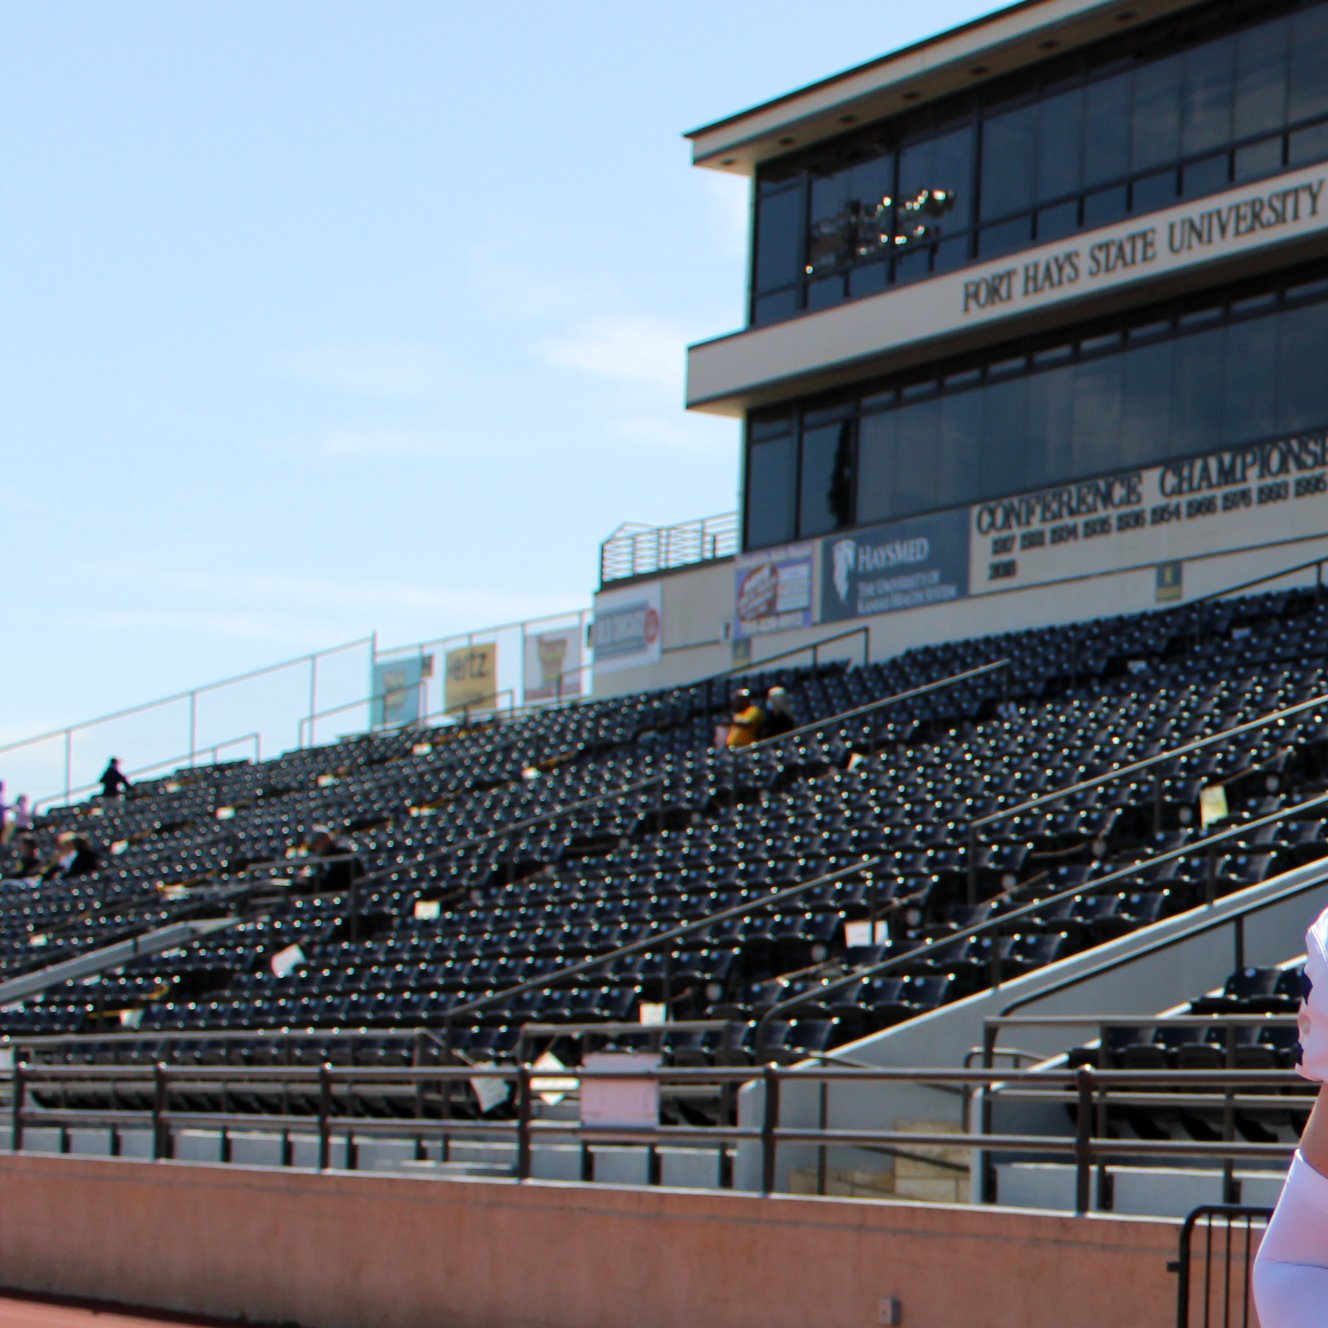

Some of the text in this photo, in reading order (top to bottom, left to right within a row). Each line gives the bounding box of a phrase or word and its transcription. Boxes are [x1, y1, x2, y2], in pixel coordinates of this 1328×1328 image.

[963, 179, 1326, 313] FORT HAYS STATE UNIVERSITY
[976, 470, 1143, 535] CONFERENCE
